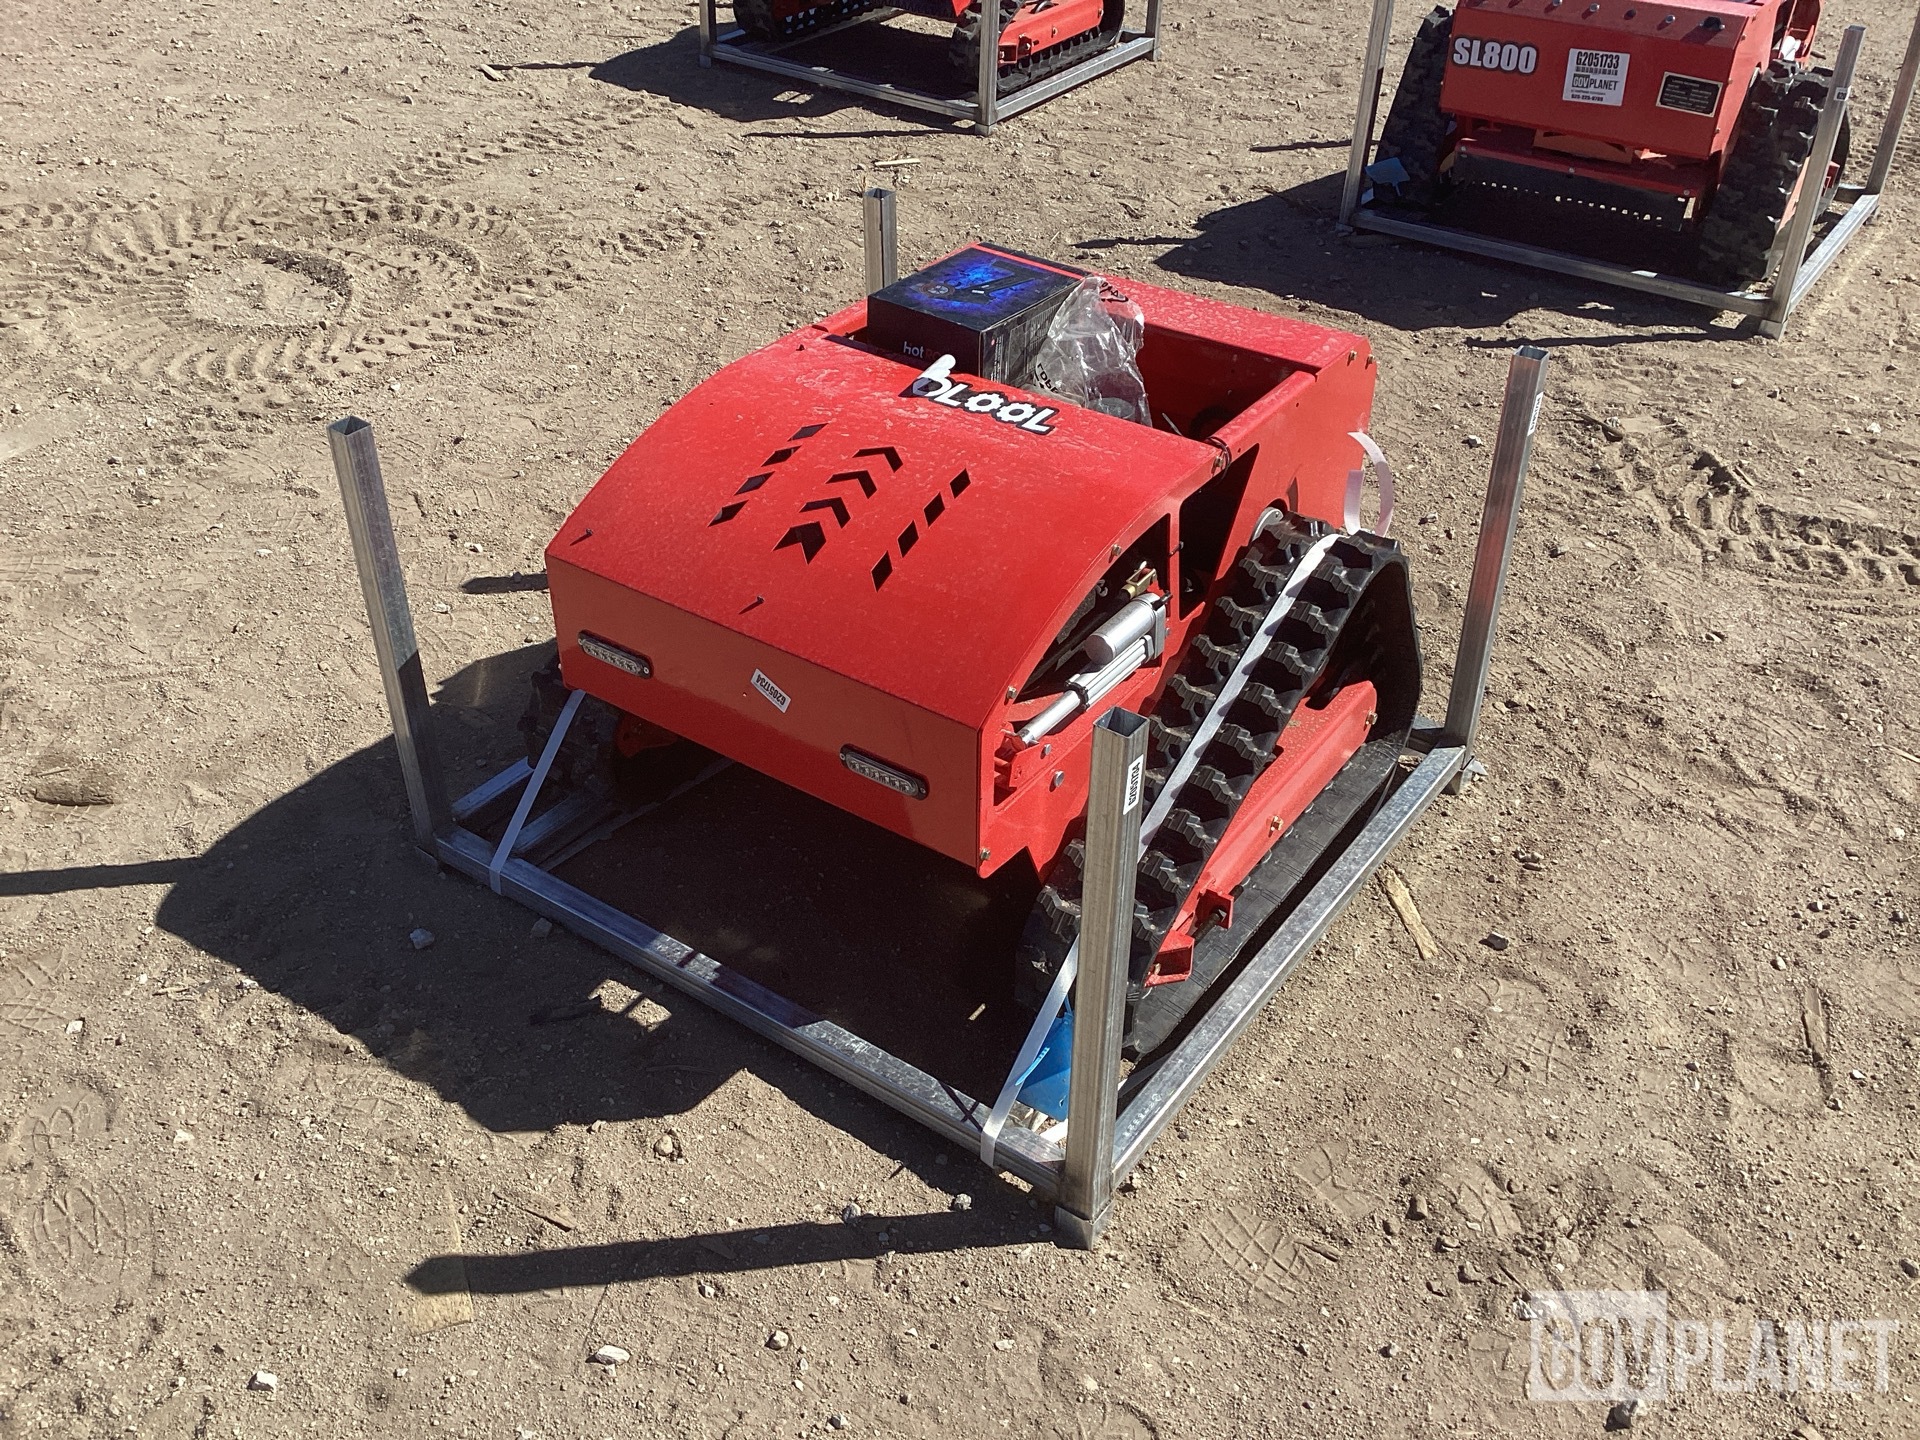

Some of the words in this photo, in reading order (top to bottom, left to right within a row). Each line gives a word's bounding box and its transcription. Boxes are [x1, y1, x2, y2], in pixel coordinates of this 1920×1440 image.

[1453, 38, 1537, 73] SL800
[1576, 51, 1620, 69] G2051733
[755, 674, 786, 706] G2051734
